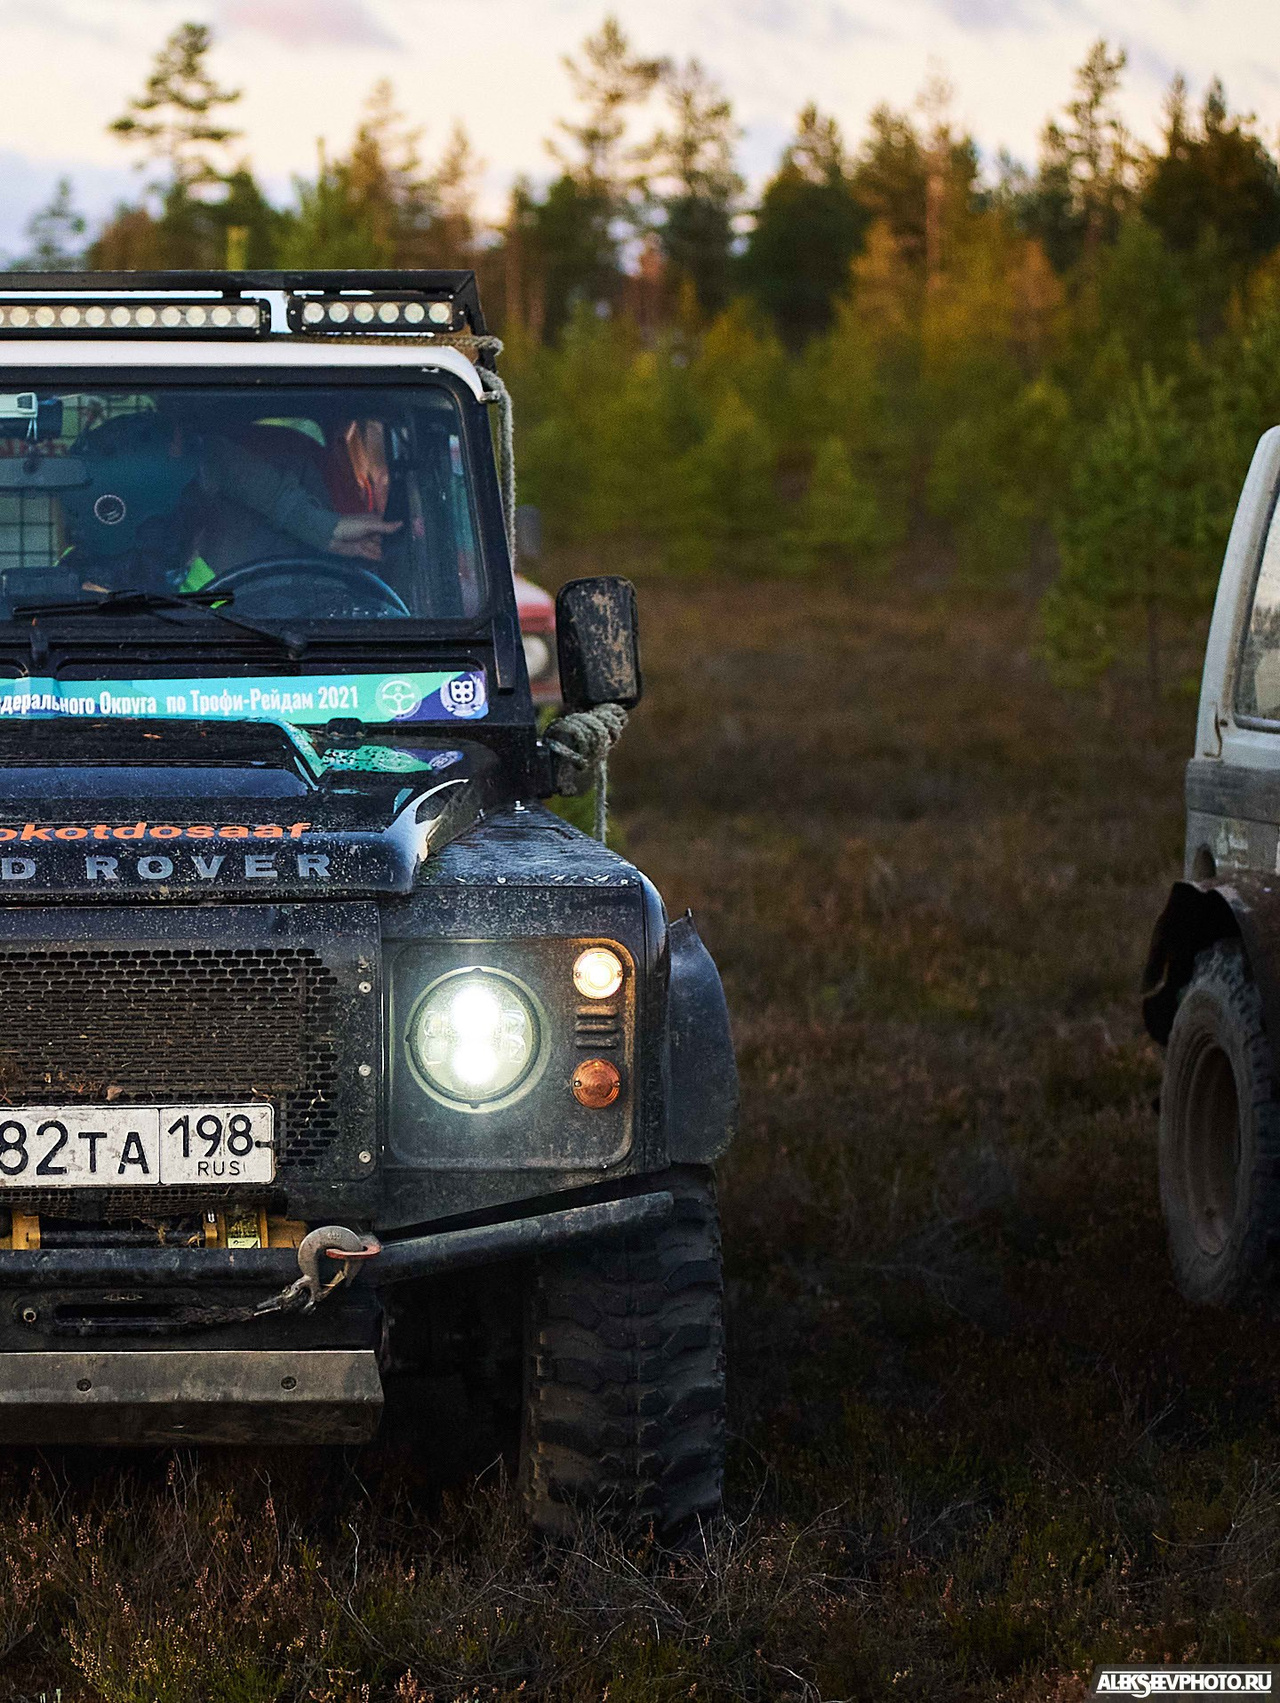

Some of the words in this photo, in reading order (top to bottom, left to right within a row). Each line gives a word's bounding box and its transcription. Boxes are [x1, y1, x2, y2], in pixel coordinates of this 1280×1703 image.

[100, 691, 157, 715] Округа
[166, 695, 186, 713] по
[190, 688, 314, 716] Трофи-Рейдам
[318, 685, 358, 710] 2021
[84, 853, 332, 880] ROVER
[167, 1113, 254, 1158] 198
[197, 1160, 241, 1176] RUS
